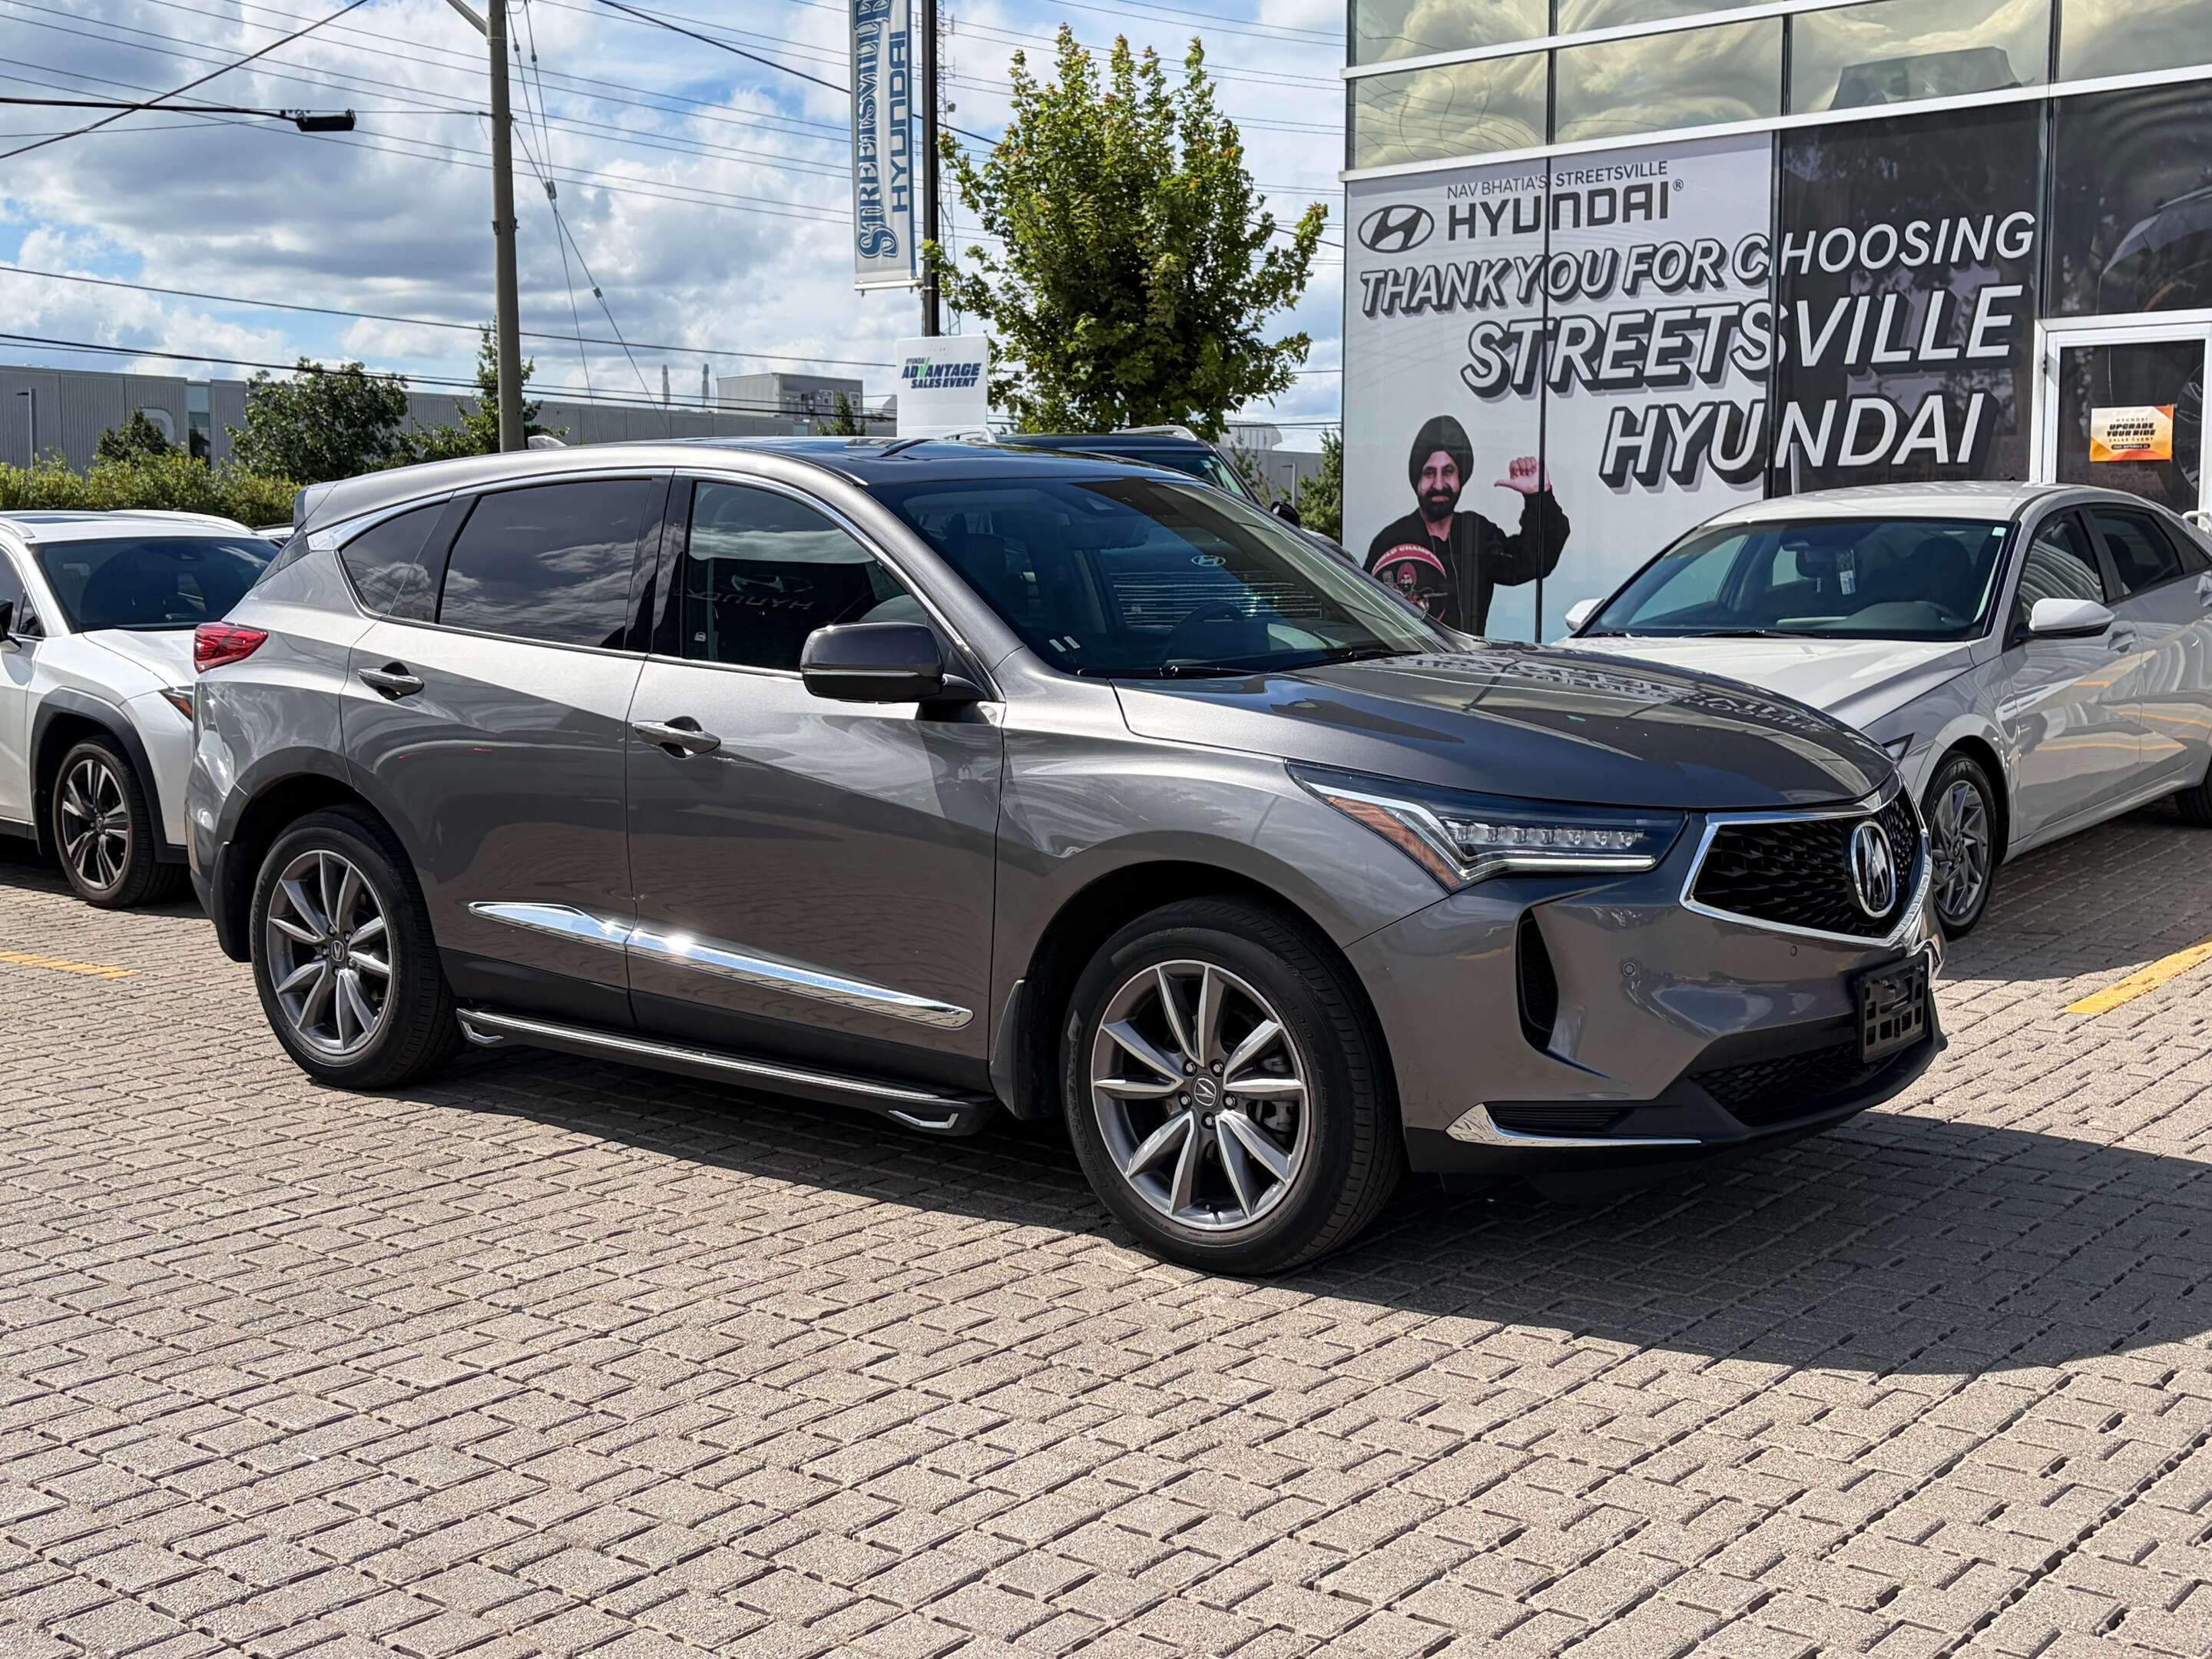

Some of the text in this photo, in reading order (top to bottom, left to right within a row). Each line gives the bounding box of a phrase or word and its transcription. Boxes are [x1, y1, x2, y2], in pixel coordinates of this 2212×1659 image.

[889, 31, 908, 213] HYUNDAI
[1447, 161, 1667, 199] NAV BHATIA'S STREETSVILLE
[1360, 210, 2036, 320] THANK YOU FOR CHOOSING
[902, 358, 982, 379] ADVANTAGE
[911, 377, 979, 389] SALES EVENT
[1461, 283, 2028, 399] STREETSVILLE
[1599, 391, 1991, 493] HYUNDAI
